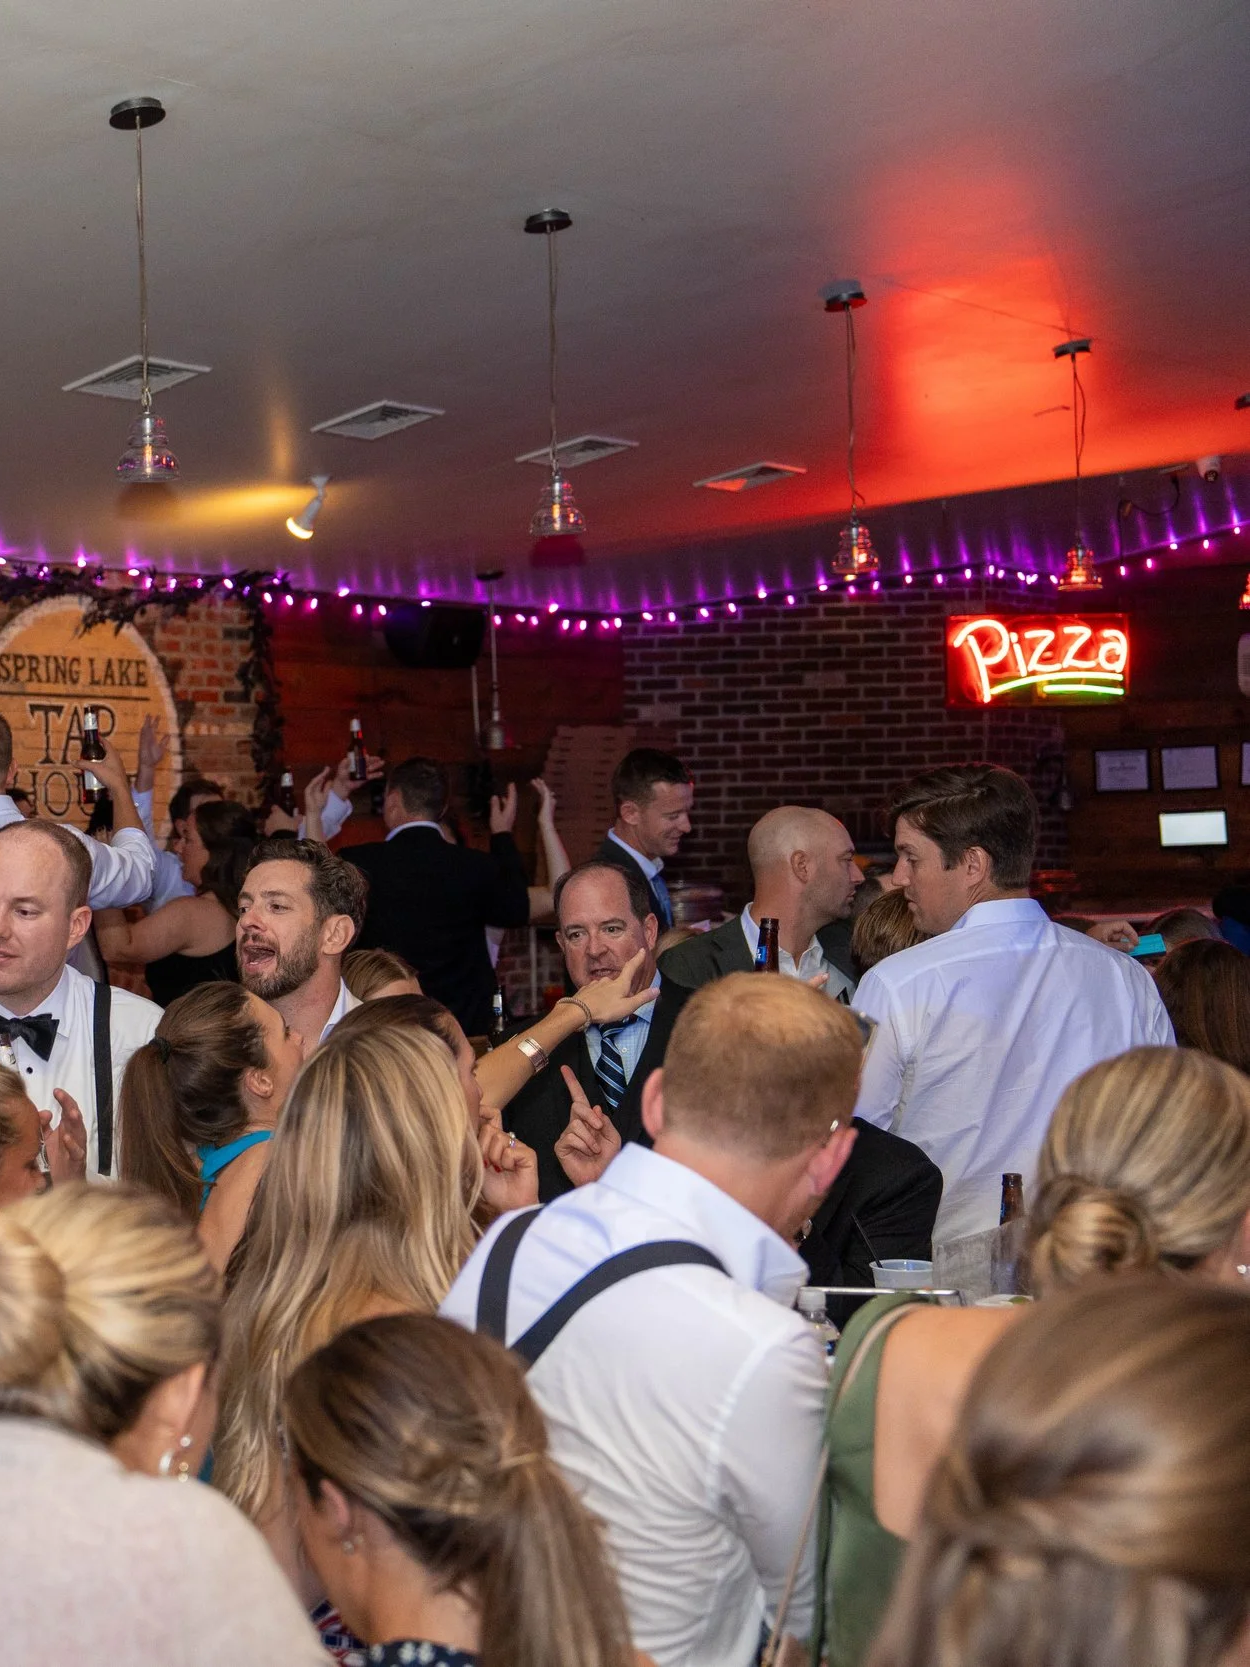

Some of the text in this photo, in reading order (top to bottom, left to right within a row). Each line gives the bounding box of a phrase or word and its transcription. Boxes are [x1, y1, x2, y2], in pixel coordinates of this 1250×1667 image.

[89, 656, 148, 688] LAKE
[953, 618, 1128, 703] Pizza
[29, 703, 116, 765] TAP
